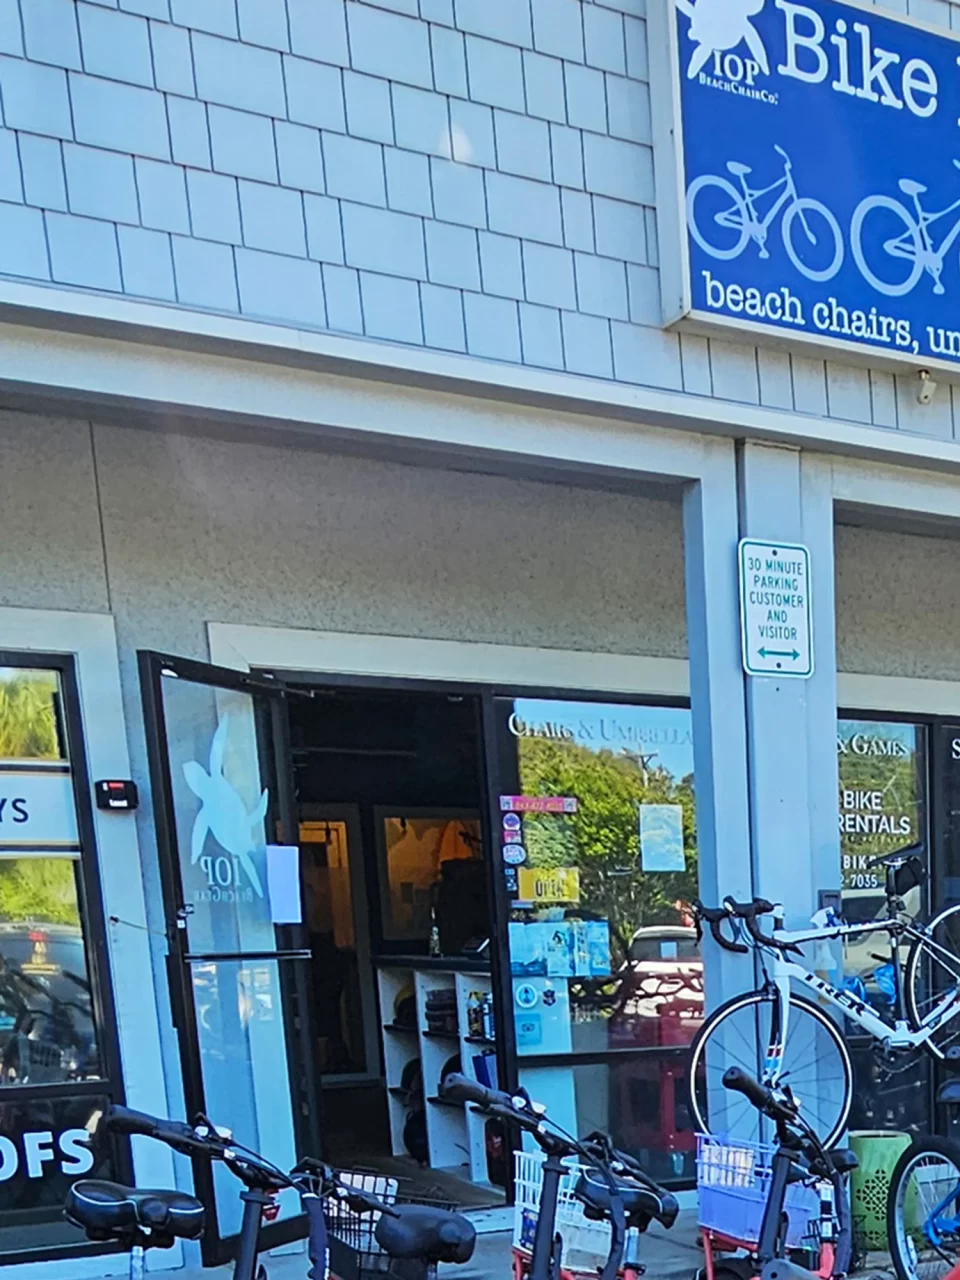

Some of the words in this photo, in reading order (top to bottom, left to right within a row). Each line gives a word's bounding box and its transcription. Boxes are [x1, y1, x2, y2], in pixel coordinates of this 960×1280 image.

[713, 51, 759, 86] IOP
[778, 0, 938, 118] Bike
[702, 271, 805, 326] beach
[812, 296, 918, 356] chairs,
[748, 557, 761, 571] 30
[765, 559, 803, 576] MINUTE
[753, 574, 798, 591] PARKING
[749, 591, 804, 609] CUSTOMER
[766, 610, 788, 624] AND
[758, 625, 798, 641] VISITOR
[843, 790, 883, 811] BIKE
